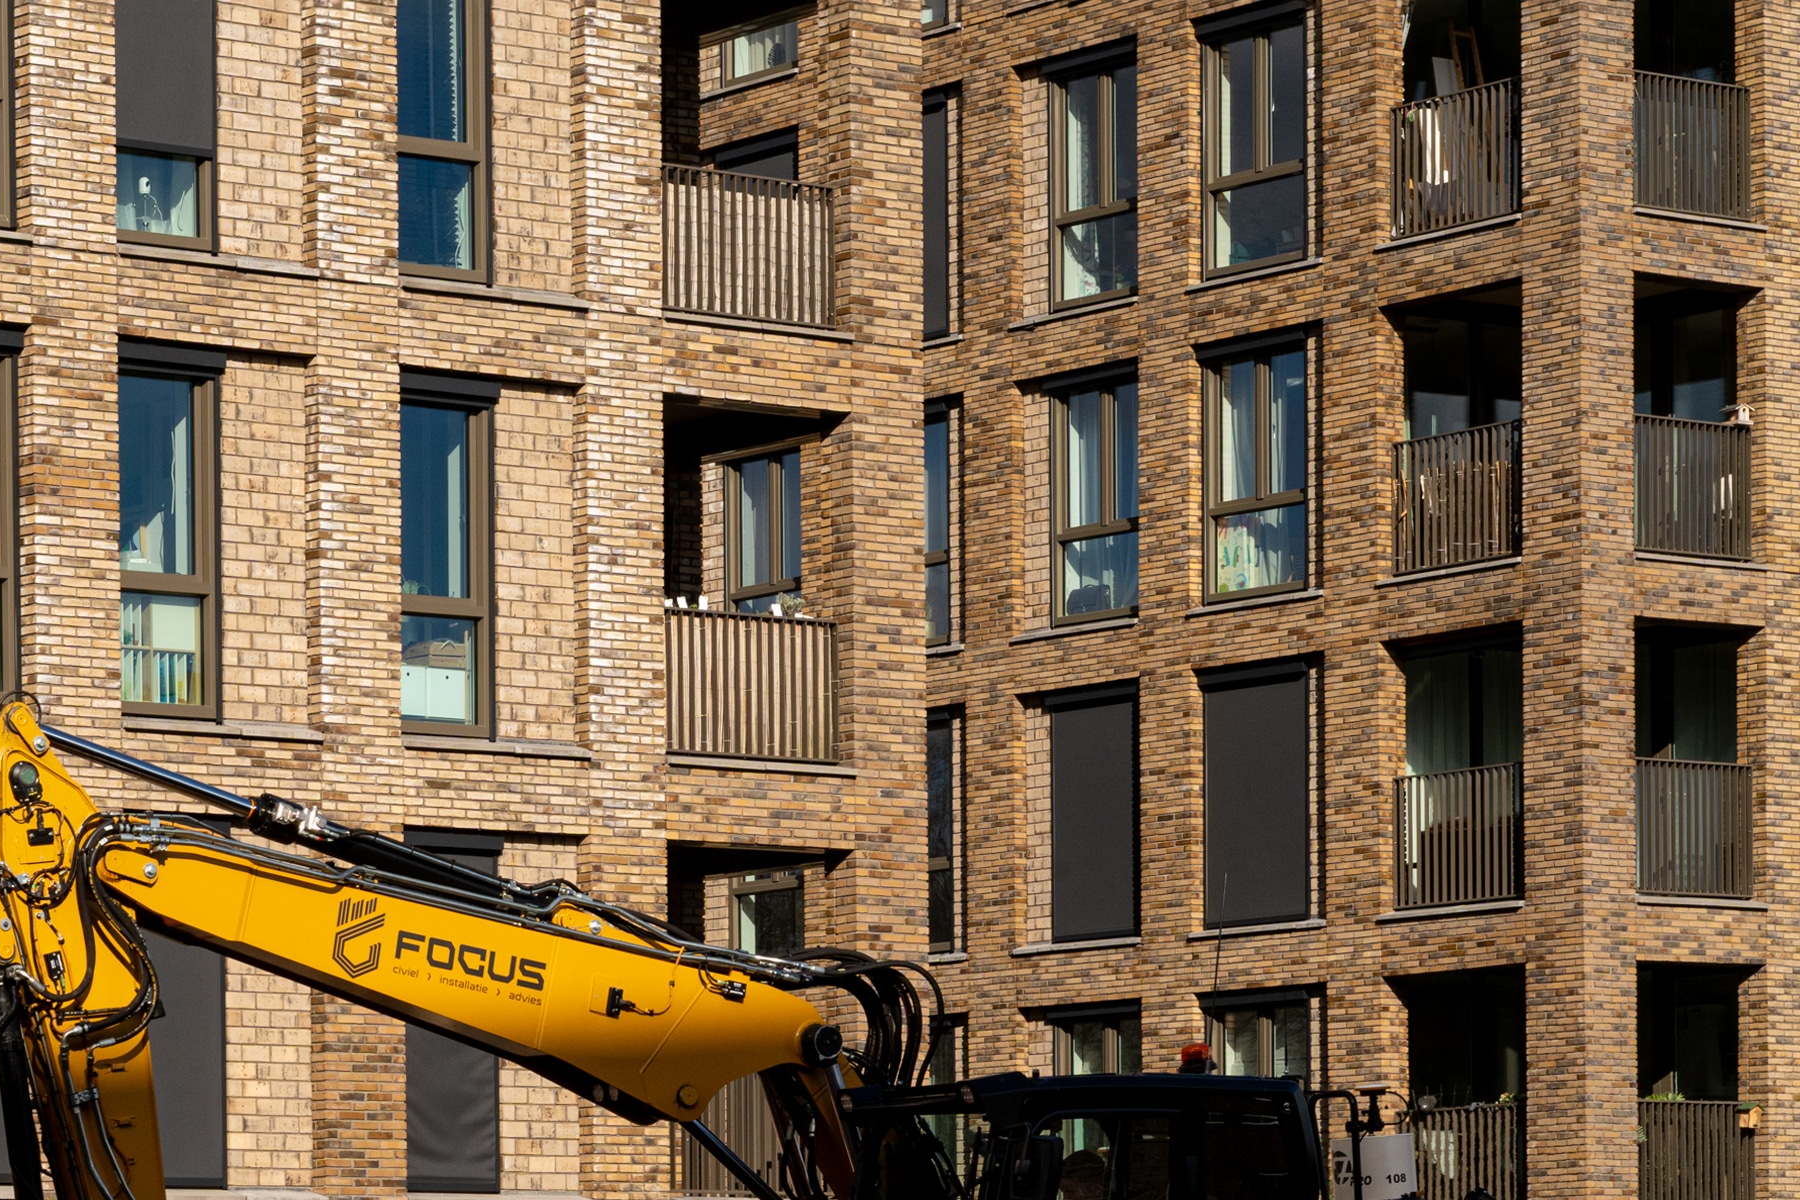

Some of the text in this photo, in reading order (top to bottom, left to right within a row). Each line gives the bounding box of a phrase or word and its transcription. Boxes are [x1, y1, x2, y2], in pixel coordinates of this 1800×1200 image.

[395, 930, 546, 991] FOCUS
[392, 965, 542, 1006] civiel installatie advies
[1386, 1173, 1406, 1184] 108
